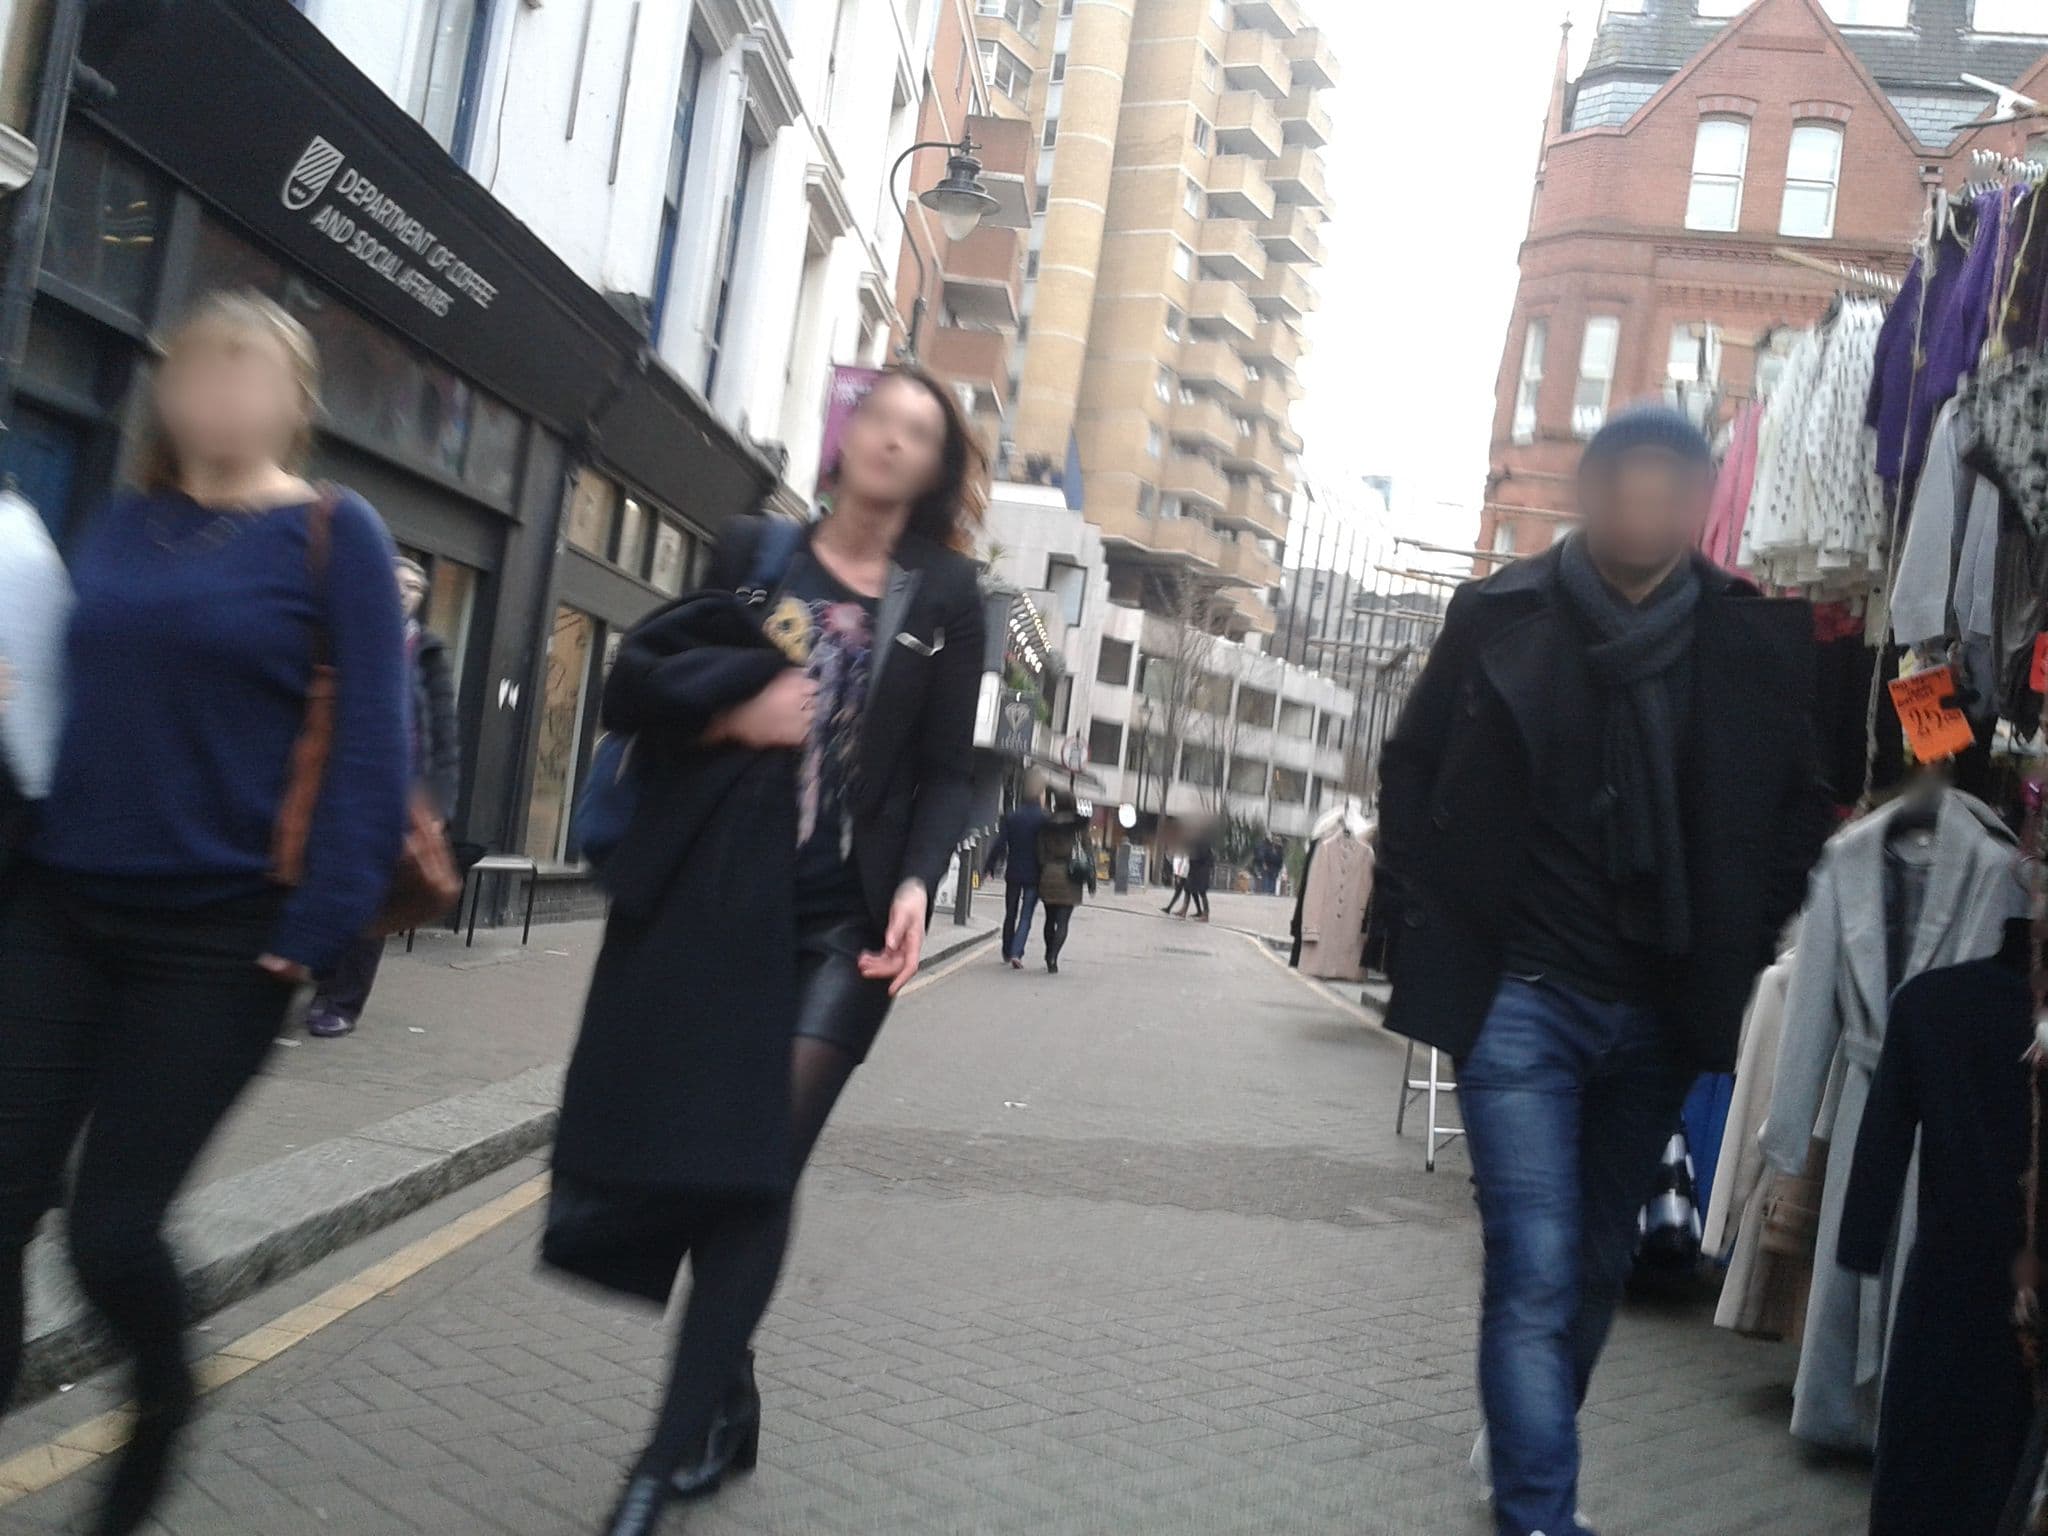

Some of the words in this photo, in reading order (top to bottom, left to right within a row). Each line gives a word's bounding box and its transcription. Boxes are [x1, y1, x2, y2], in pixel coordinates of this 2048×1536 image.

[310, 204, 356, 243] AND
[347, 229, 402, 282] SOCIAL
[399, 267, 455, 317] AFFAIRS
[335, 168, 437, 256] DEPARTMENT
[427, 244, 457, 271] OF
[446, 261, 498, 309] COFFEE
